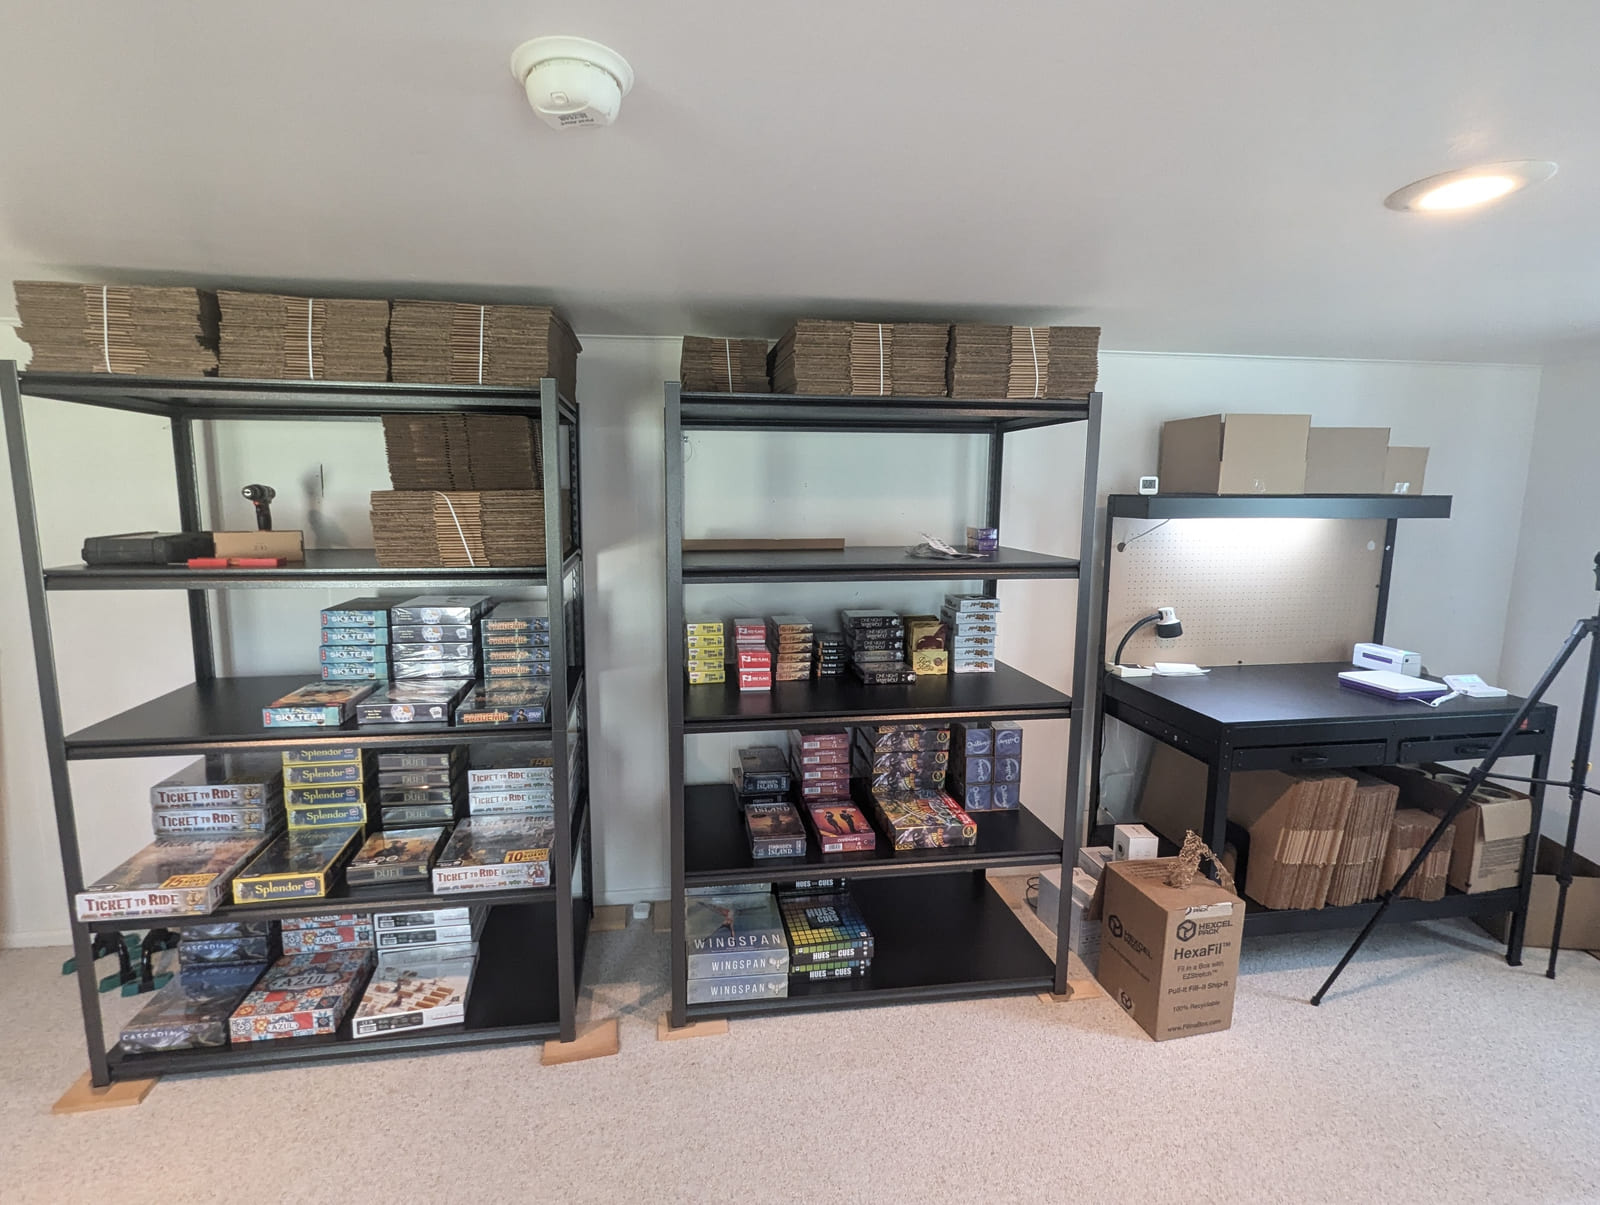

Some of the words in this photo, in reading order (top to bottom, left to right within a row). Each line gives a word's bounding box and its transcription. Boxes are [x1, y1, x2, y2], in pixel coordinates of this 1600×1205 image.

[298, 713, 325, 721] TEAM
[401, 757, 426, 767] DUEL
[302, 764, 344, 780] Splendor
[472, 773, 498, 783] TICKET
[508, 771, 525, 779] RIDE
[402, 774, 426, 784] DUEL
[158, 791, 198, 803] TICKET
[211, 788, 237, 799] RIDE
[303, 786, 345, 802] Splendor
[509, 793, 527, 801] RIDE
[160, 815, 199, 827] TICKET
[212, 812, 238, 823] RIDE
[306, 806, 349, 823] Splendor
[507, 851, 523, 863] 10
[768, 848, 793, 856] ISLAND
[374, 868, 401, 879] DUEL
[437, 871, 469, 882] TICKET
[479, 868, 500, 877] RIDE
[254, 878, 304, 897] Splendor
[796, 880, 811, 888] HUES
[85, 897, 132, 911] TICKET
[135, 898, 146, 906] TO
[148, 893, 178, 905] RIDE
[805, 906, 836, 918] HUES
[817, 914, 840, 923] CUES
[1199, 920, 1233, 930] HEXCEL
[1198, 928, 1220, 936] PACK
[318, 935, 340, 944] AZUL
[694, 933, 782, 950] WINGSPAN
[180, 942, 227, 951] CASCADIA
[813, 951, 830, 960] HUES
[838, 948, 855, 957] CUES
[711, 958, 766, 972] WINGSPAN
[809, 970, 826, 979] HUES
[835, 967, 852, 976] CUES
[280, 974, 328, 987] AZUL
[710, 983, 765, 997] WINGSPAN
[271, 1022, 294, 1031] AZUL
[122, 1030, 178, 1041] CASCADIA
